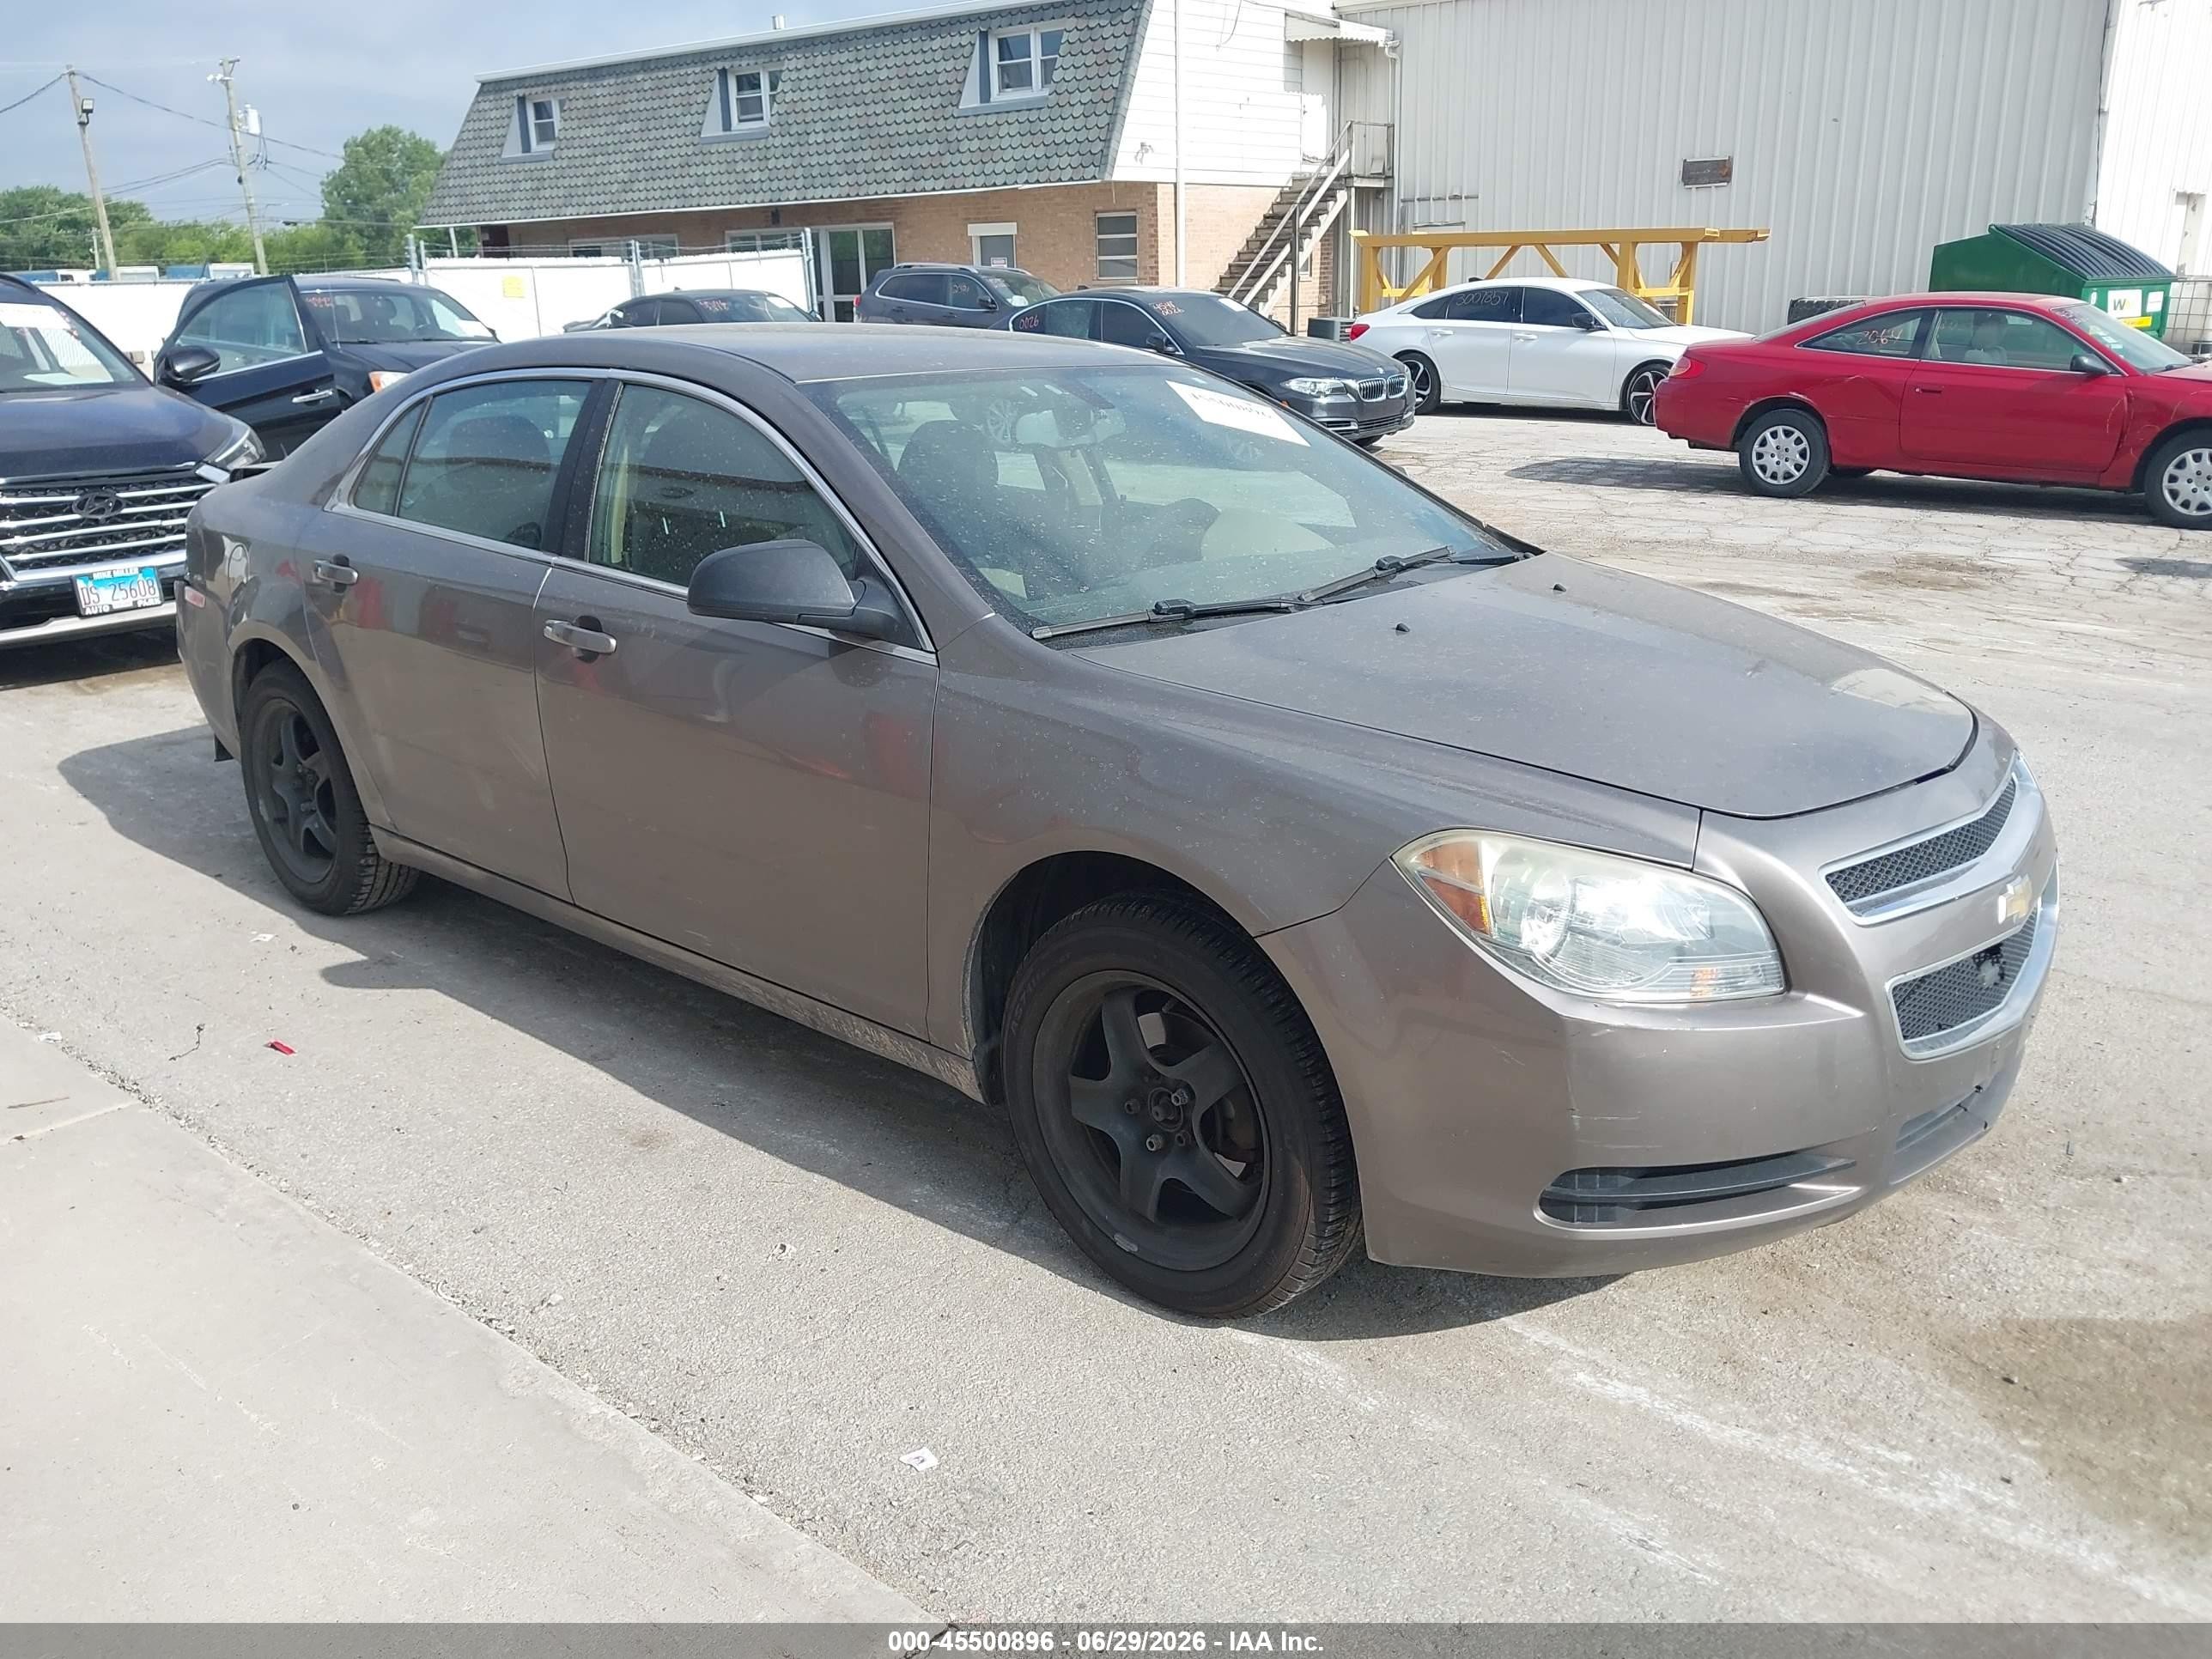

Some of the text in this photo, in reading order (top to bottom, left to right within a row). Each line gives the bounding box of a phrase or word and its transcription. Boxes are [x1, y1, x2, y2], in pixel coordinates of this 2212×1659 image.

[1019, 314, 1039, 330] 0026
[109, 578, 156, 602] 25608
[85, 605, 110, 616] AUTO
